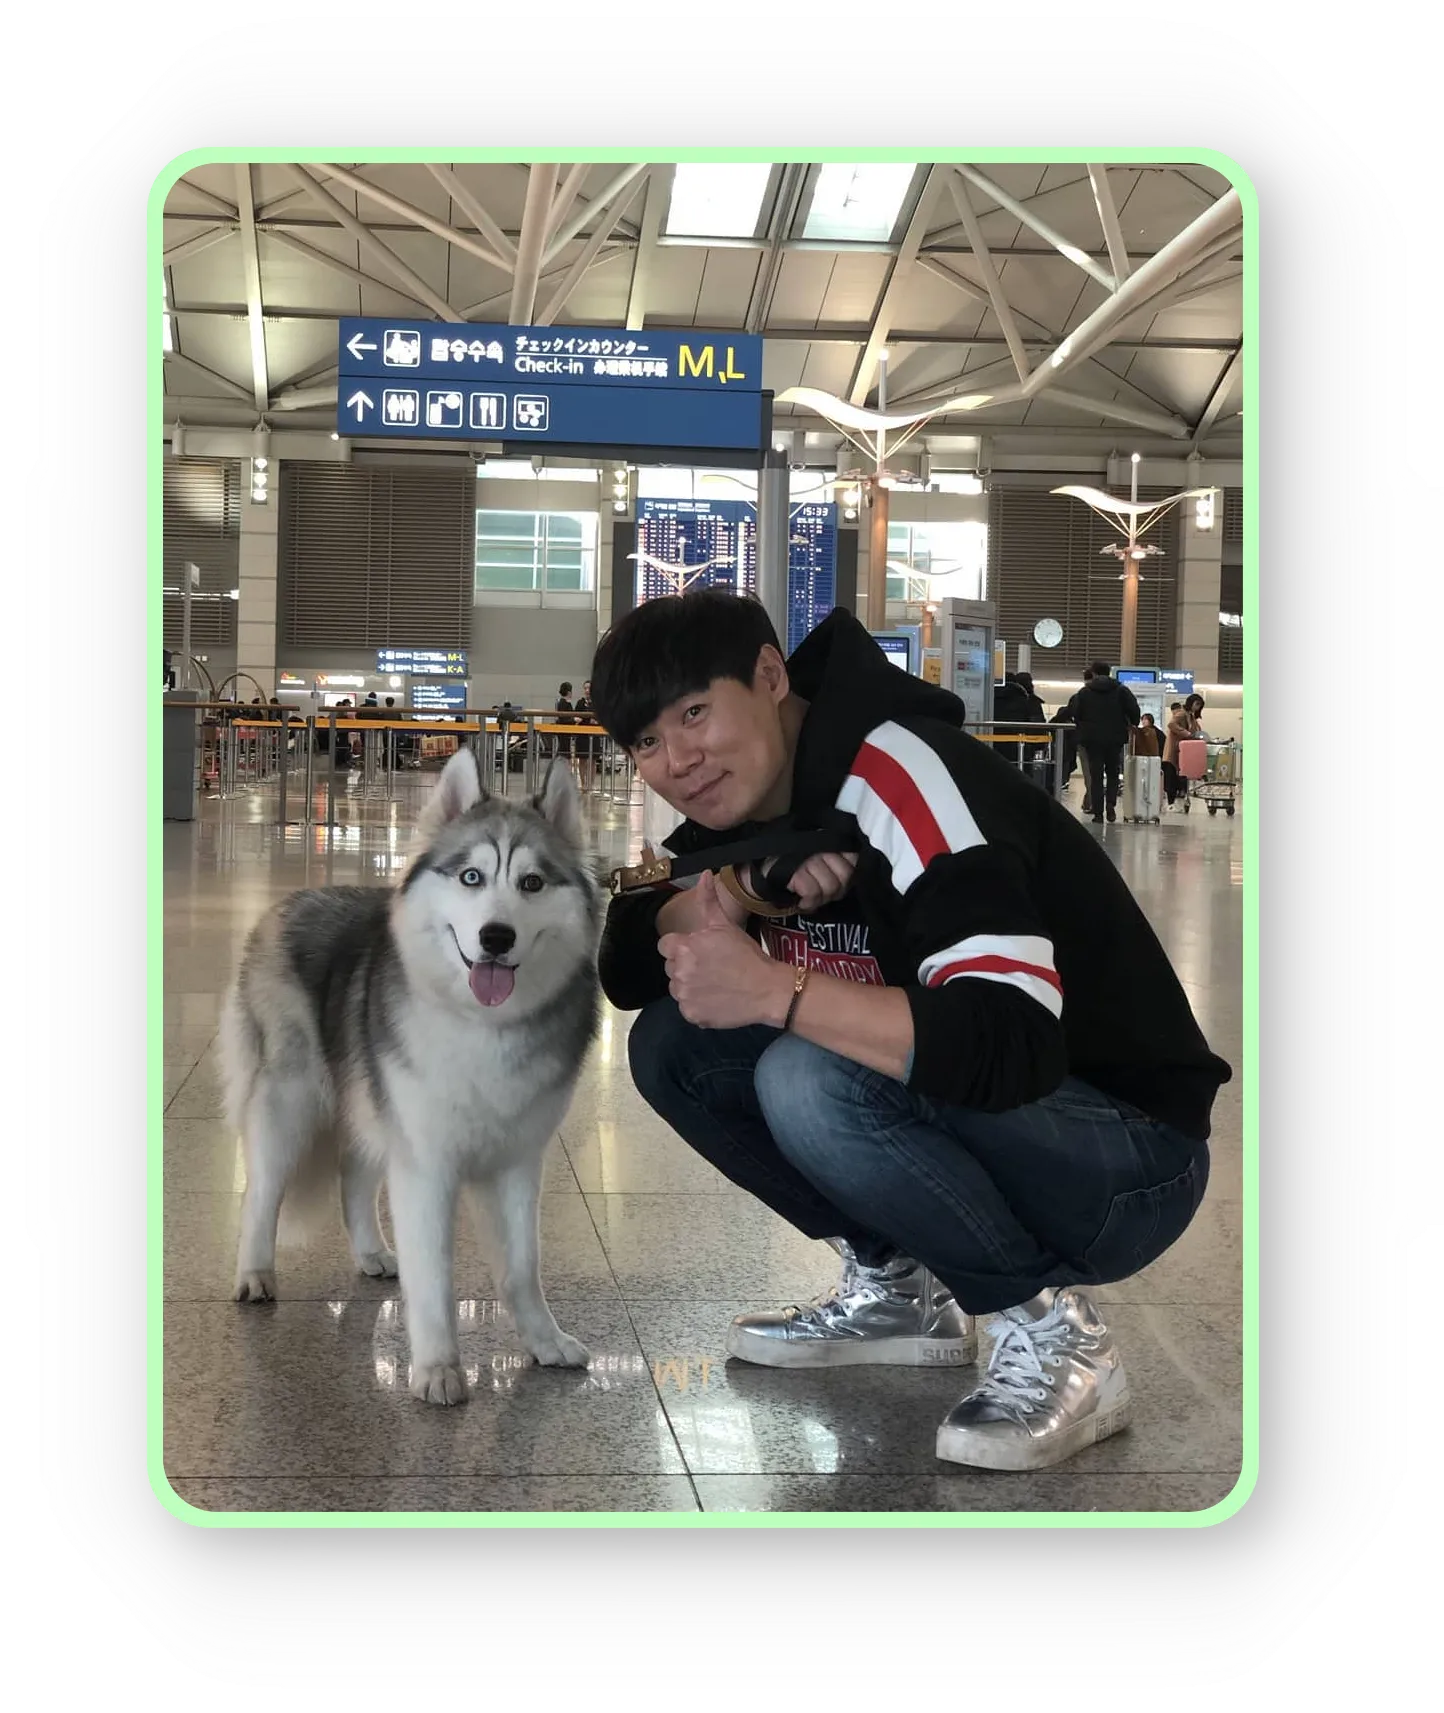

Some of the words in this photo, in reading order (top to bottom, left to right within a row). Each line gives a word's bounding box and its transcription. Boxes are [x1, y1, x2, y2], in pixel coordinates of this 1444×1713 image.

[515, 336, 649, 355] チェックインカウンター
[514, 357, 584, 375] Check-in
[803, 506, 829, 517] 15:33
